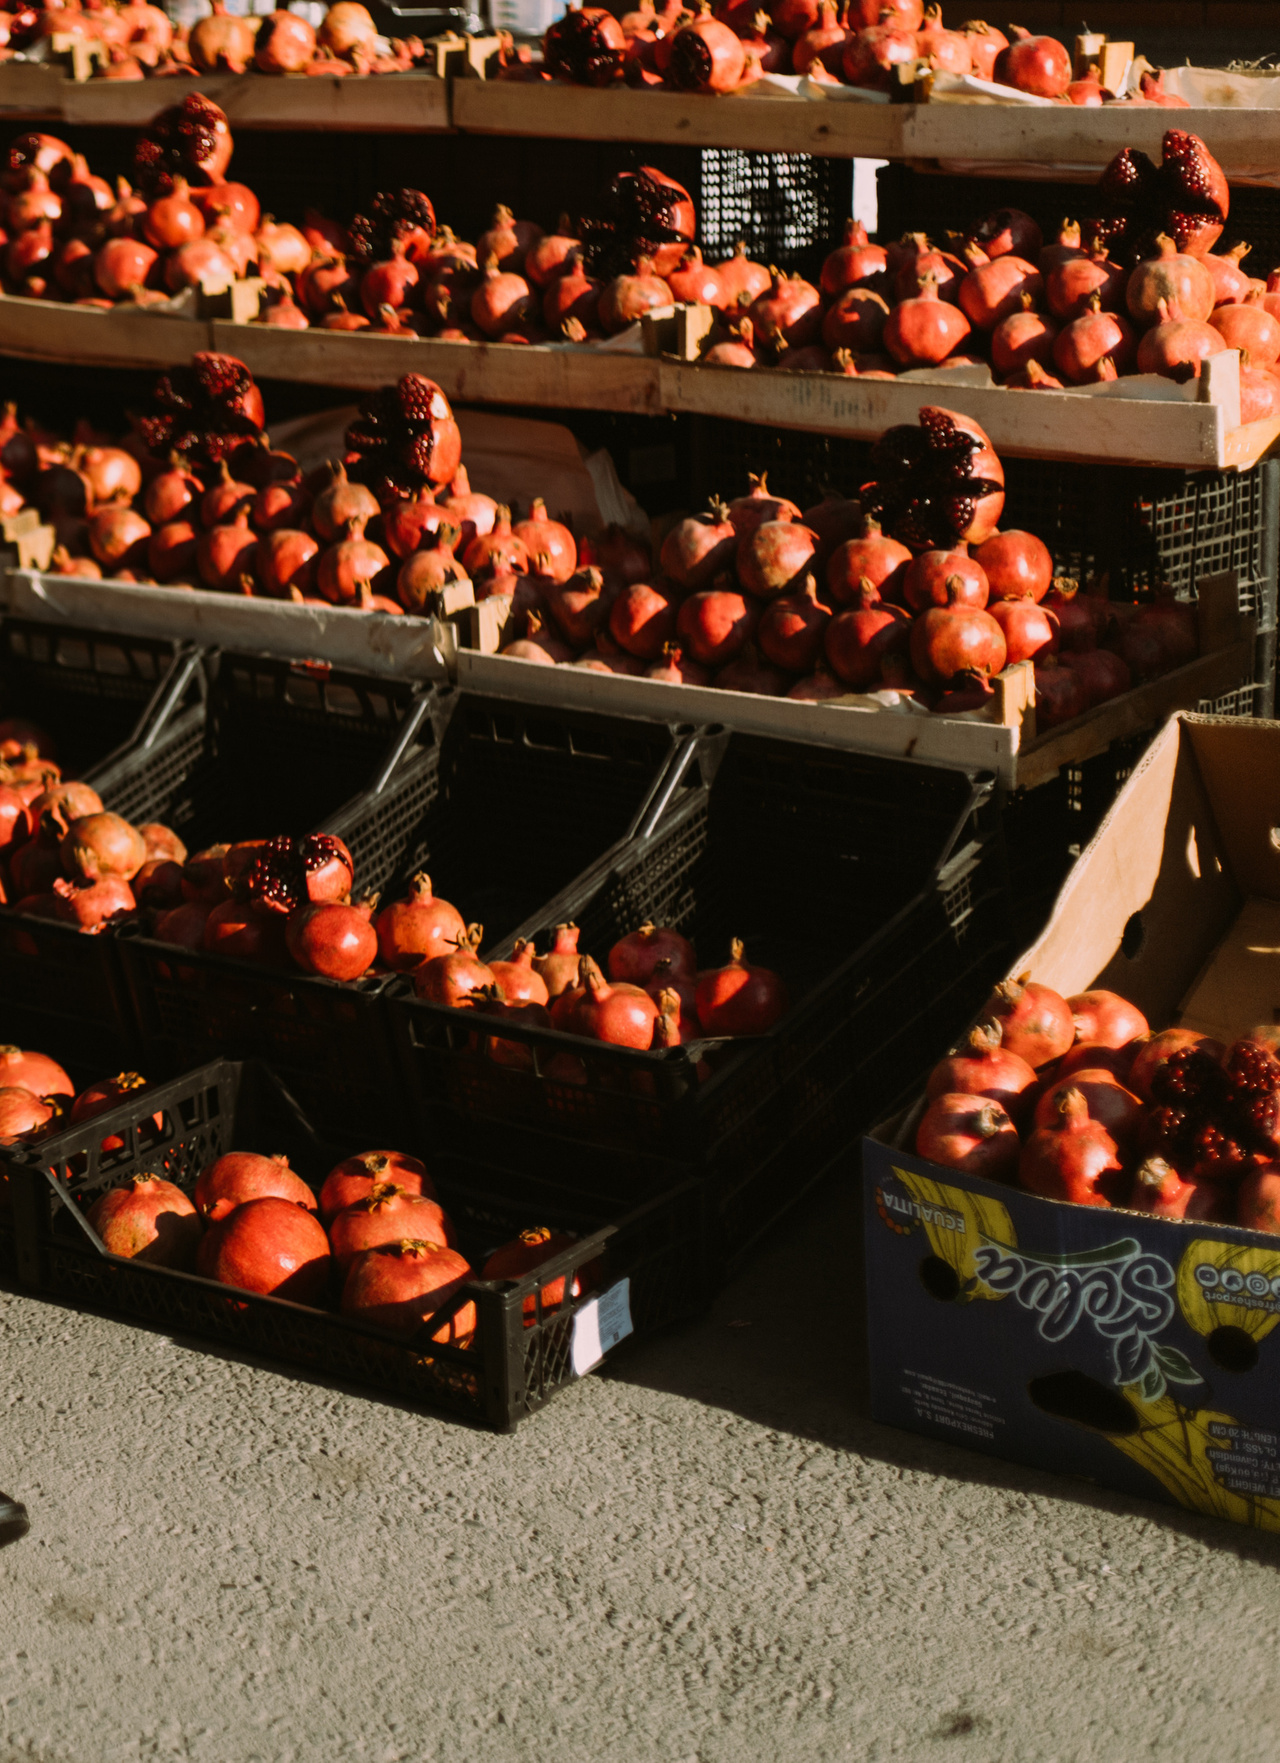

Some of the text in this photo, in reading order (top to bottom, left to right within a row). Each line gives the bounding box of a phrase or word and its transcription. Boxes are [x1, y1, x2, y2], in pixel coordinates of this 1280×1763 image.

[882, 1190, 966, 1234] ECUALITTA
[973, 1245, 1176, 1342] Selva
[934, 1412, 995, 1440] FRESHEXPORT
[1212, 1425, 1226, 1436] CM
[1228, 1427, 1239, 1438] 20
[1209, 1449, 1259, 1468] Cavendish
[1242, 1442, 1277, 1457] CLASS:
[1227, 1477, 1280, 1496] ET WEIGHT:
